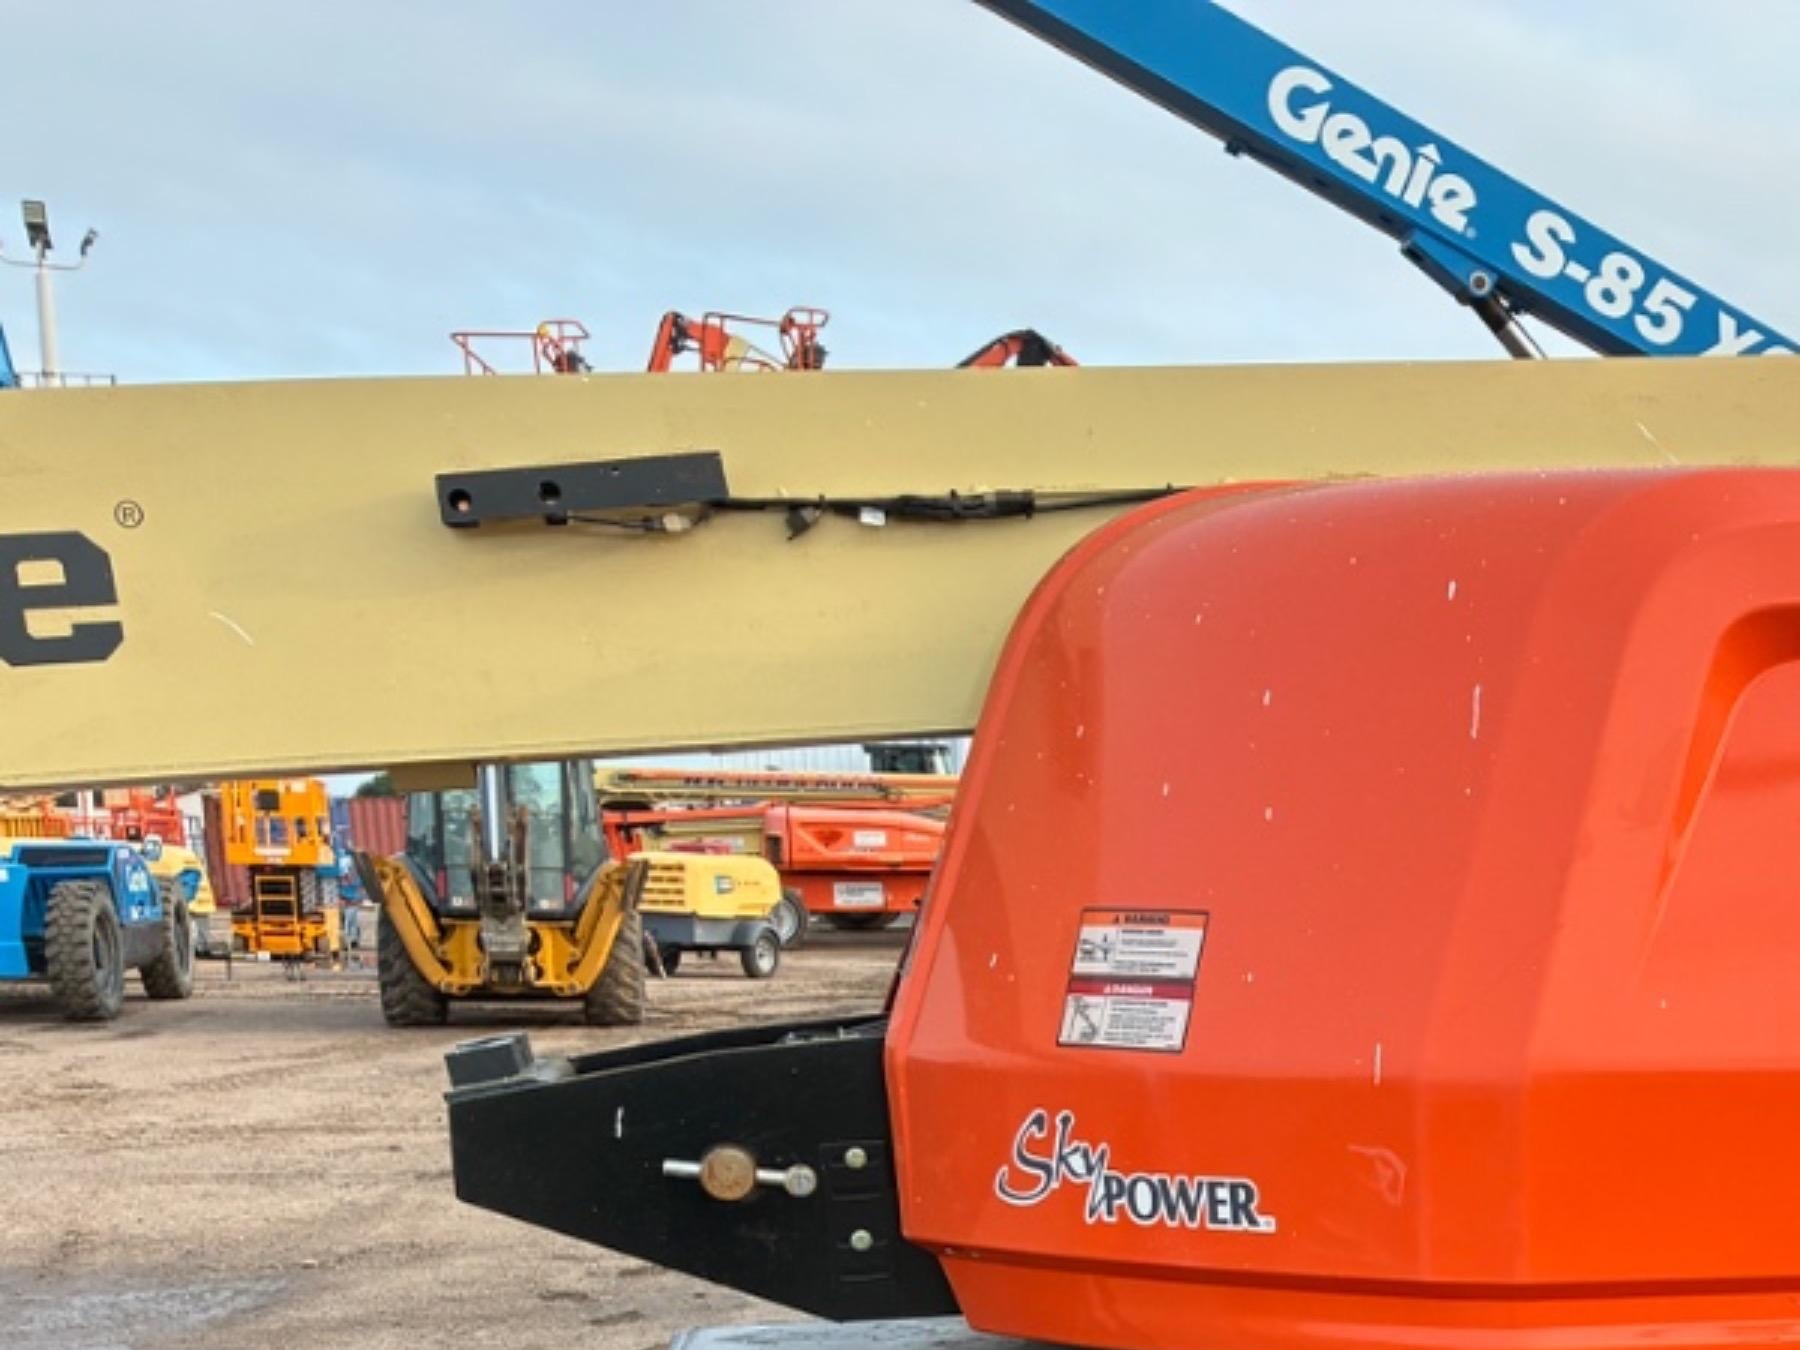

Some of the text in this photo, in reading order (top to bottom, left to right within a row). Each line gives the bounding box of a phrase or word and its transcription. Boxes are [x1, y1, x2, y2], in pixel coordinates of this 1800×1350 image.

[1267, 65, 1796, 356] Genie S-85 X
